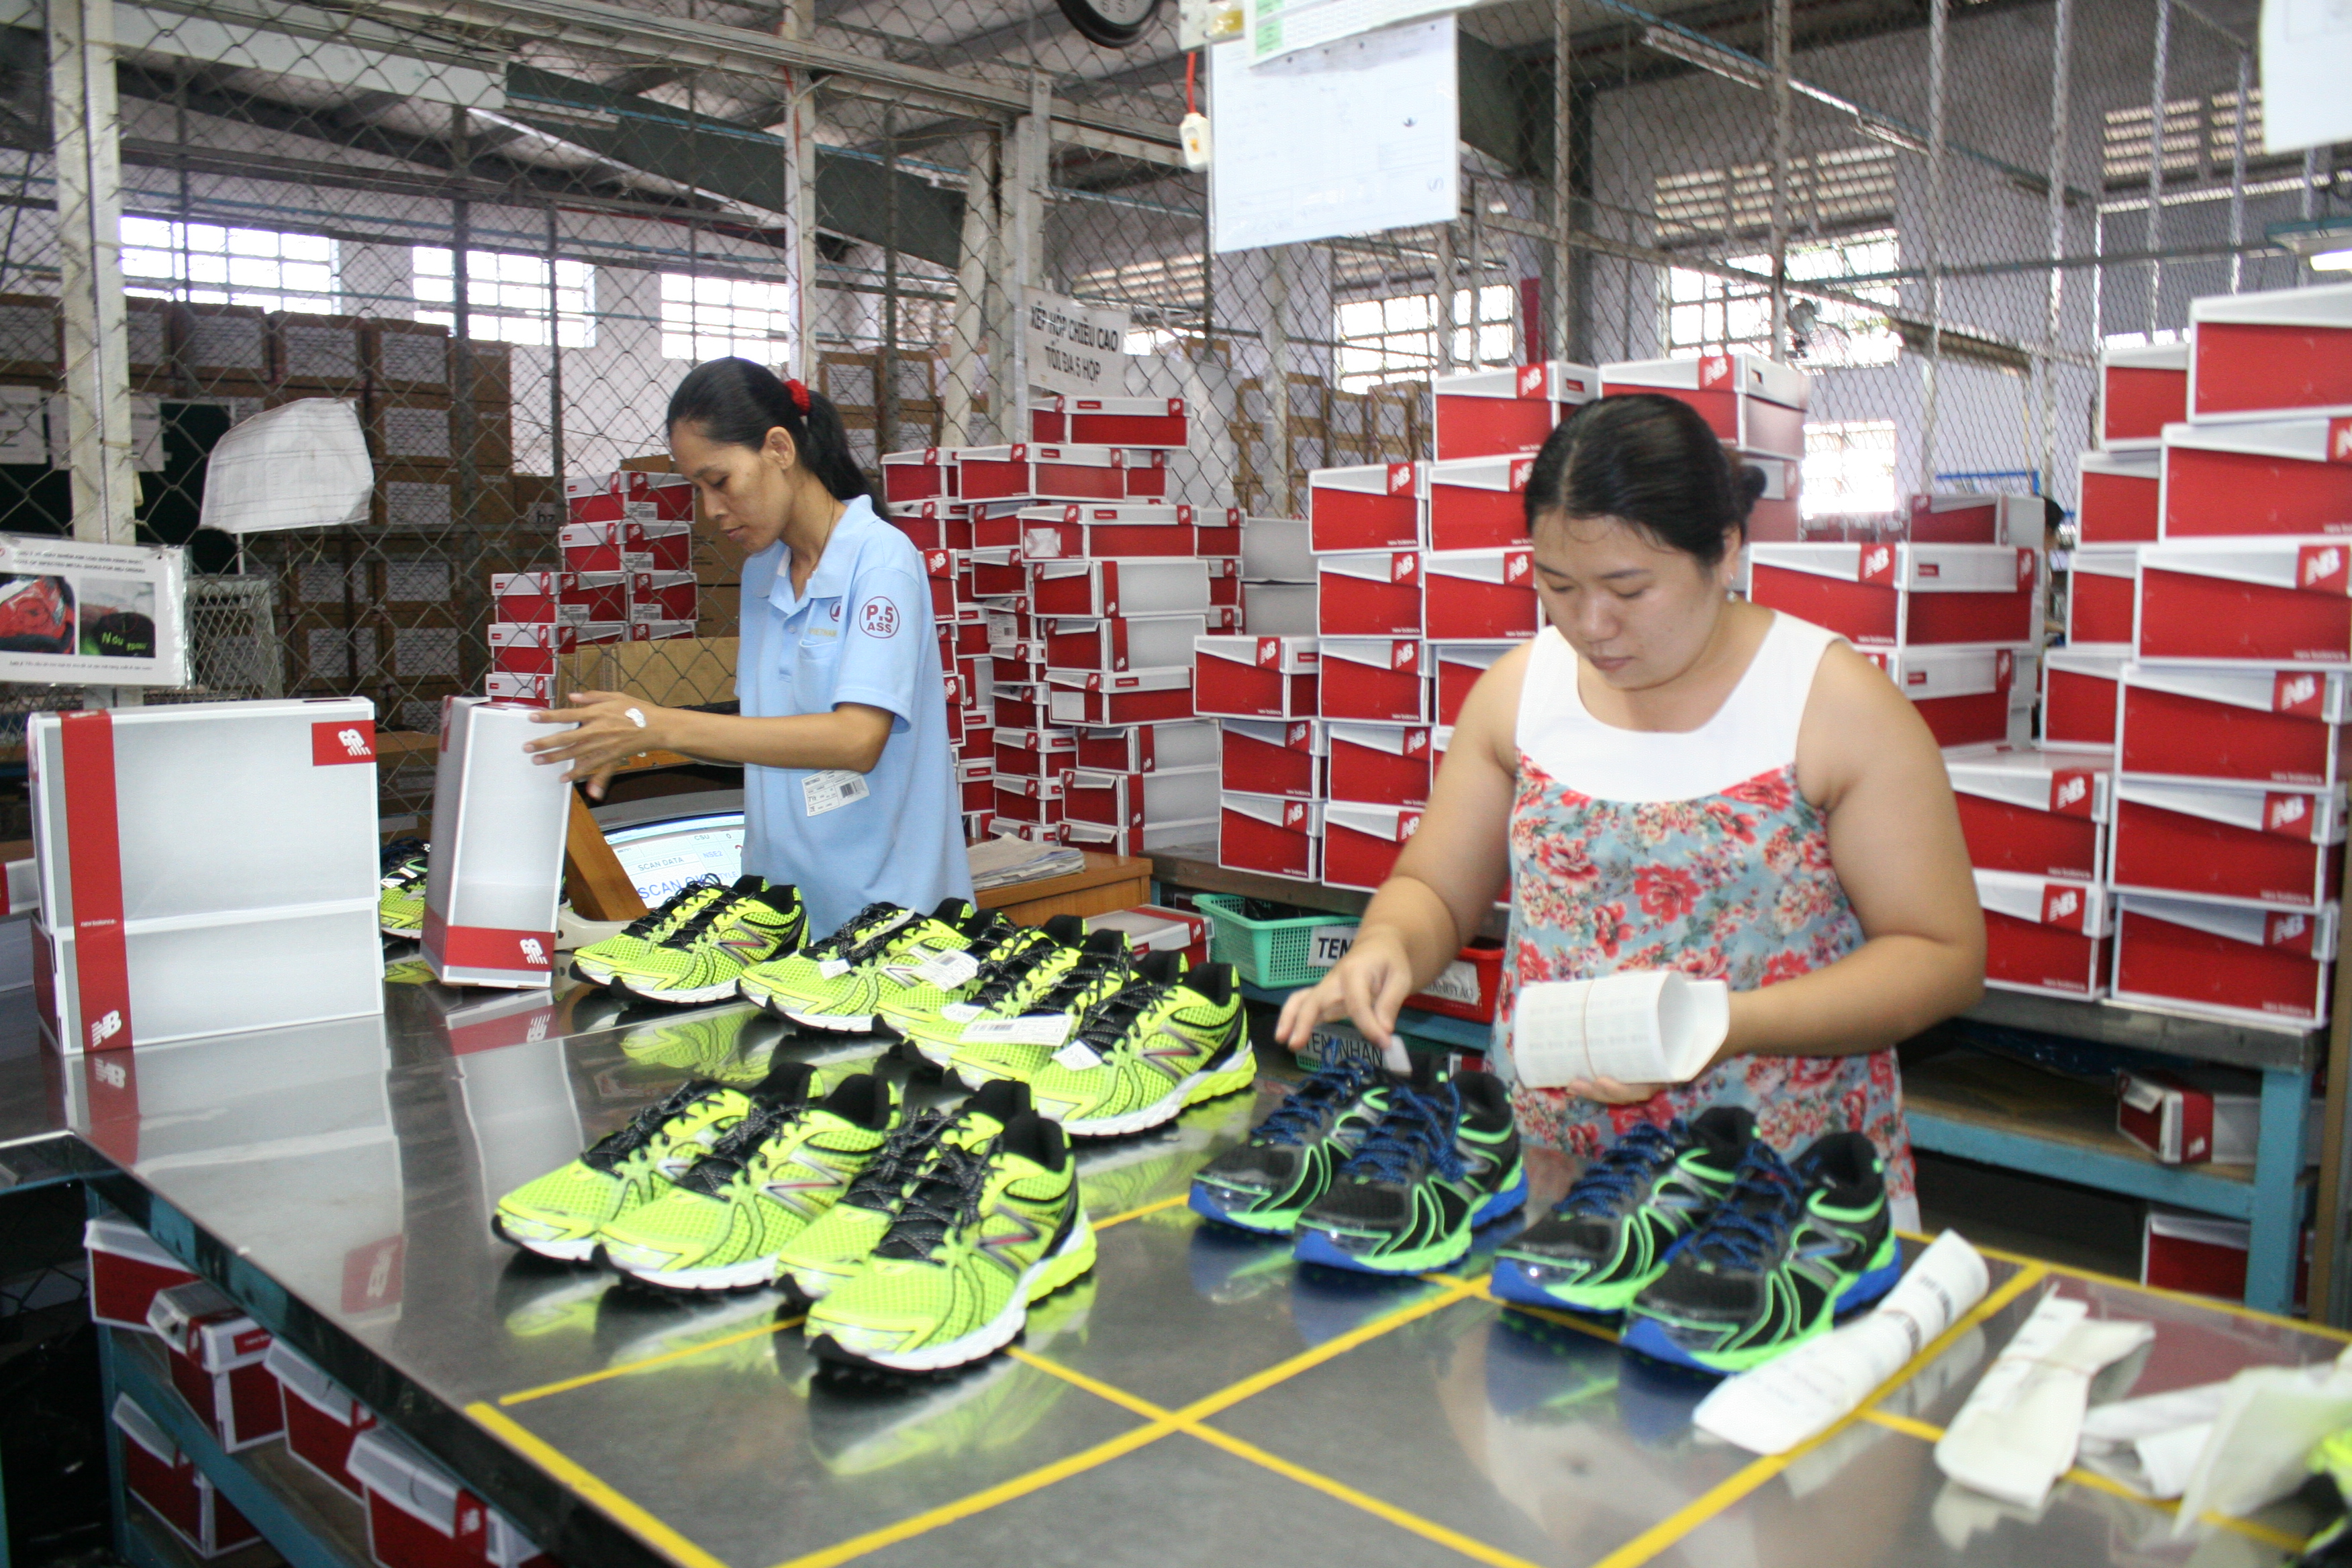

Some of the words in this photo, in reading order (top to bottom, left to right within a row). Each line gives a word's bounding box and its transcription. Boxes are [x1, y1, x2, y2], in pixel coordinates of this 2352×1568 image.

[1096, 327, 1118, 352] CAO
[1521, 366, 1542, 395] NB
[1704, 356, 1728, 387] NB
[1391, 466, 1411, 493] NB
[1395, 554, 1414, 581] NB
[1508, 554, 1529, 582] NB
[866, 604, 894, 624] P.5
[867, 622, 892, 634] ASS
[1260, 641, 1277, 664] NB
[1395, 643, 1414, 669] NB
[1289, 723, 1307, 746] NB
[1407, 730, 1426, 754] NB
[2057, 776, 2086, 810] NB
[1287, 803, 1304, 826] NB
[638, 861, 660, 871] SCAN
[662, 856, 685, 867] DATA
[638, 879, 682, 899] SCAN
[2049, 890, 2078, 922] NB
[91, 1010, 121, 1048] NB
